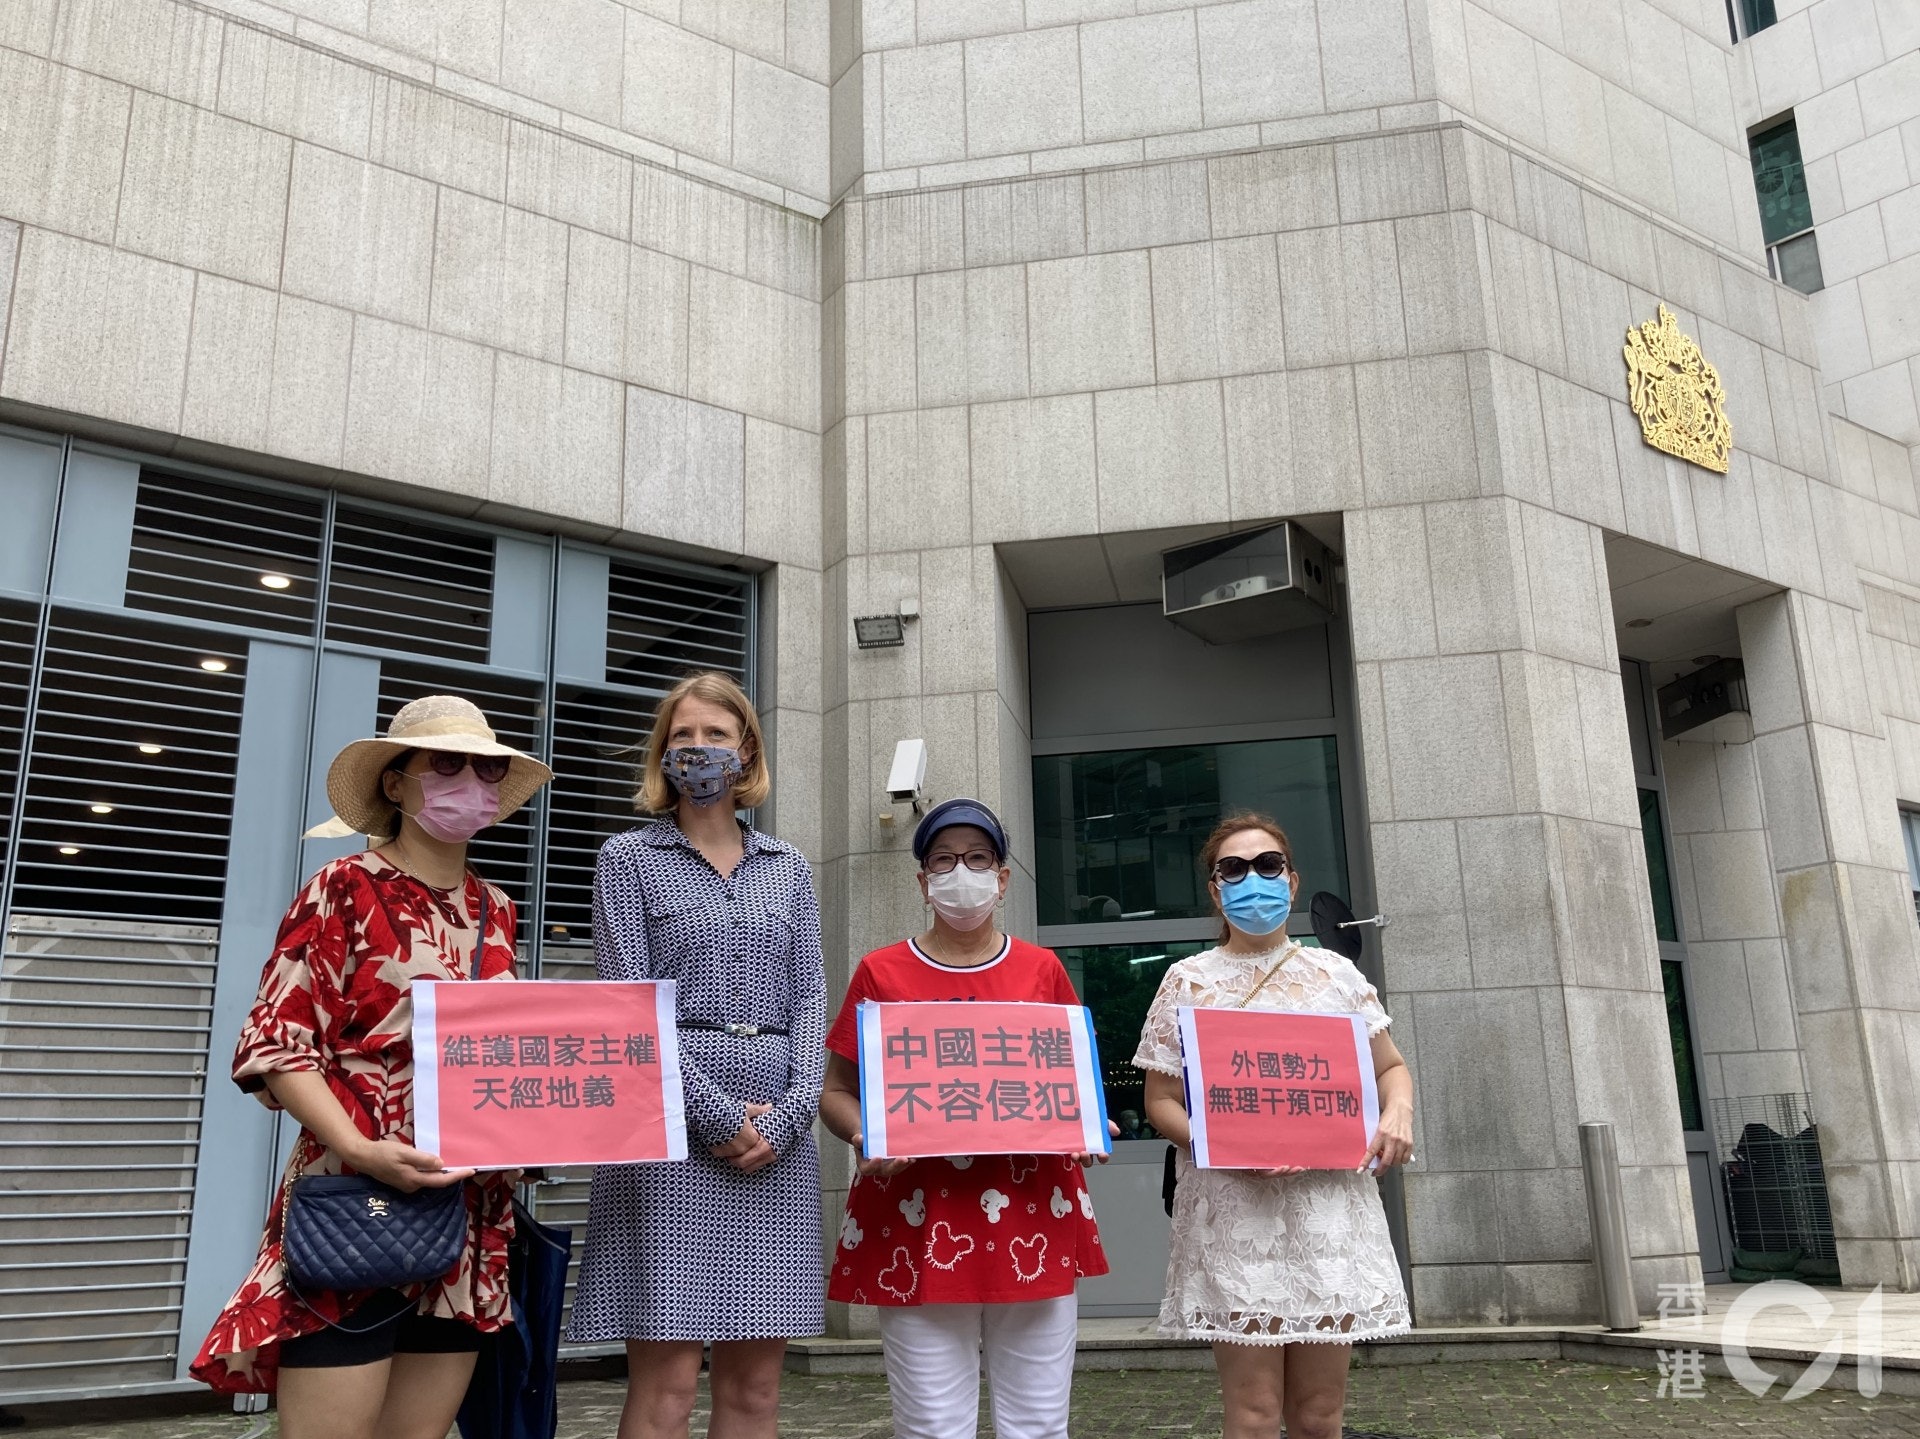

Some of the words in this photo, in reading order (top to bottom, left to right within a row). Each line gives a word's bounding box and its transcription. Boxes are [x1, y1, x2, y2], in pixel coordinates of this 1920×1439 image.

[442, 1033, 657, 1068] 維護國家主權
[886, 1026, 1075, 1070] 中國主權
[1230, 1050, 1331, 1081] 外國勢力
[473, 1074, 616, 1110] 天經地義
[888, 1078, 1081, 1123] 不容侵犯
[1208, 1084, 1360, 1118] 無理干預可恥
